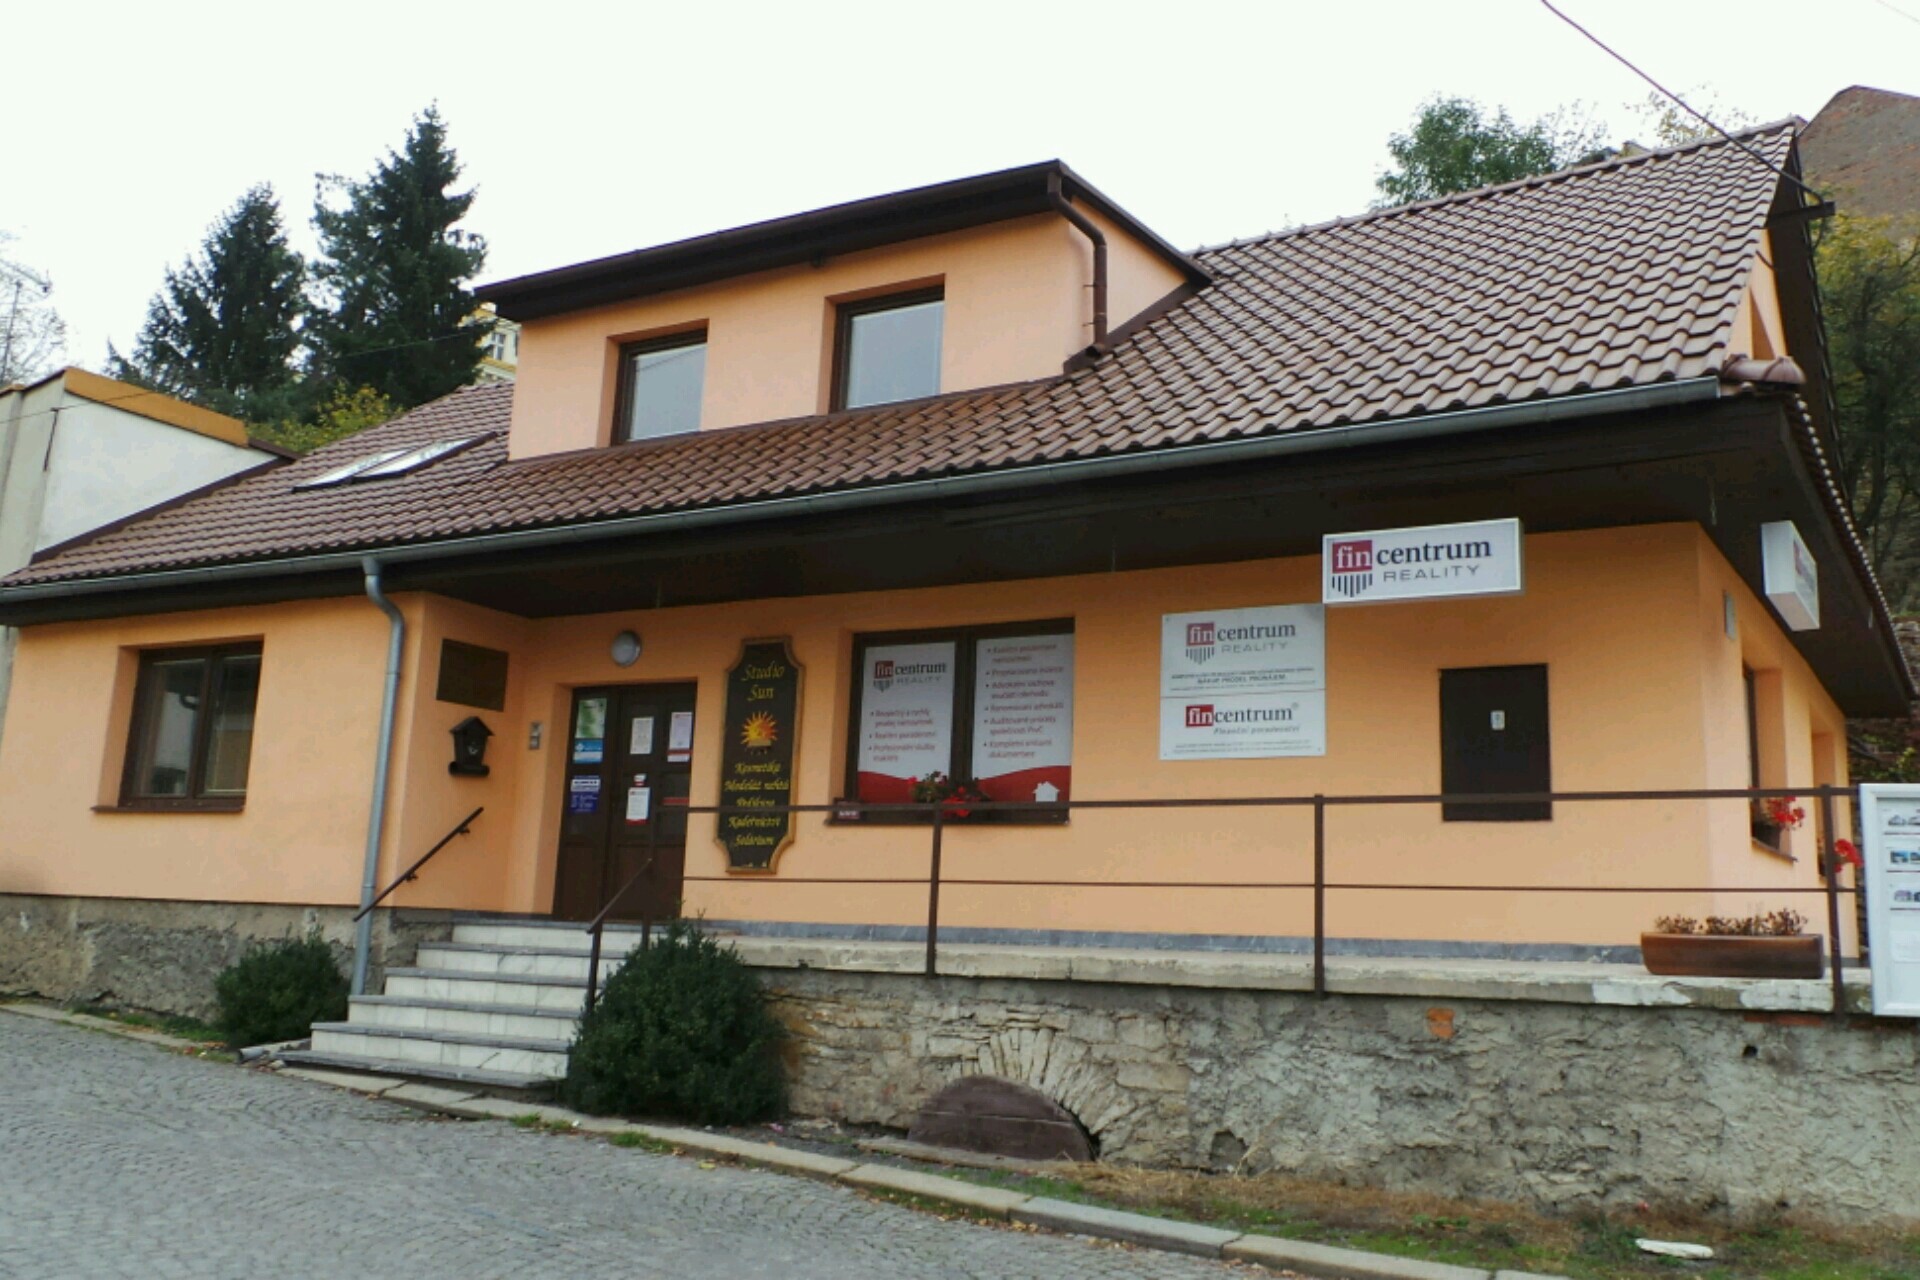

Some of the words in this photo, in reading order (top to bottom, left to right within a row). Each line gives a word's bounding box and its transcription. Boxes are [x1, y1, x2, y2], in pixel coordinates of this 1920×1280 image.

[1383, 564, 1480, 583] REALITY
[1220, 642, 1288, 654] REALITY
[741, 660, 785, 681] Studio
[896, 676, 942, 685] REALITY
[746, 684, 775, 701] Sun
